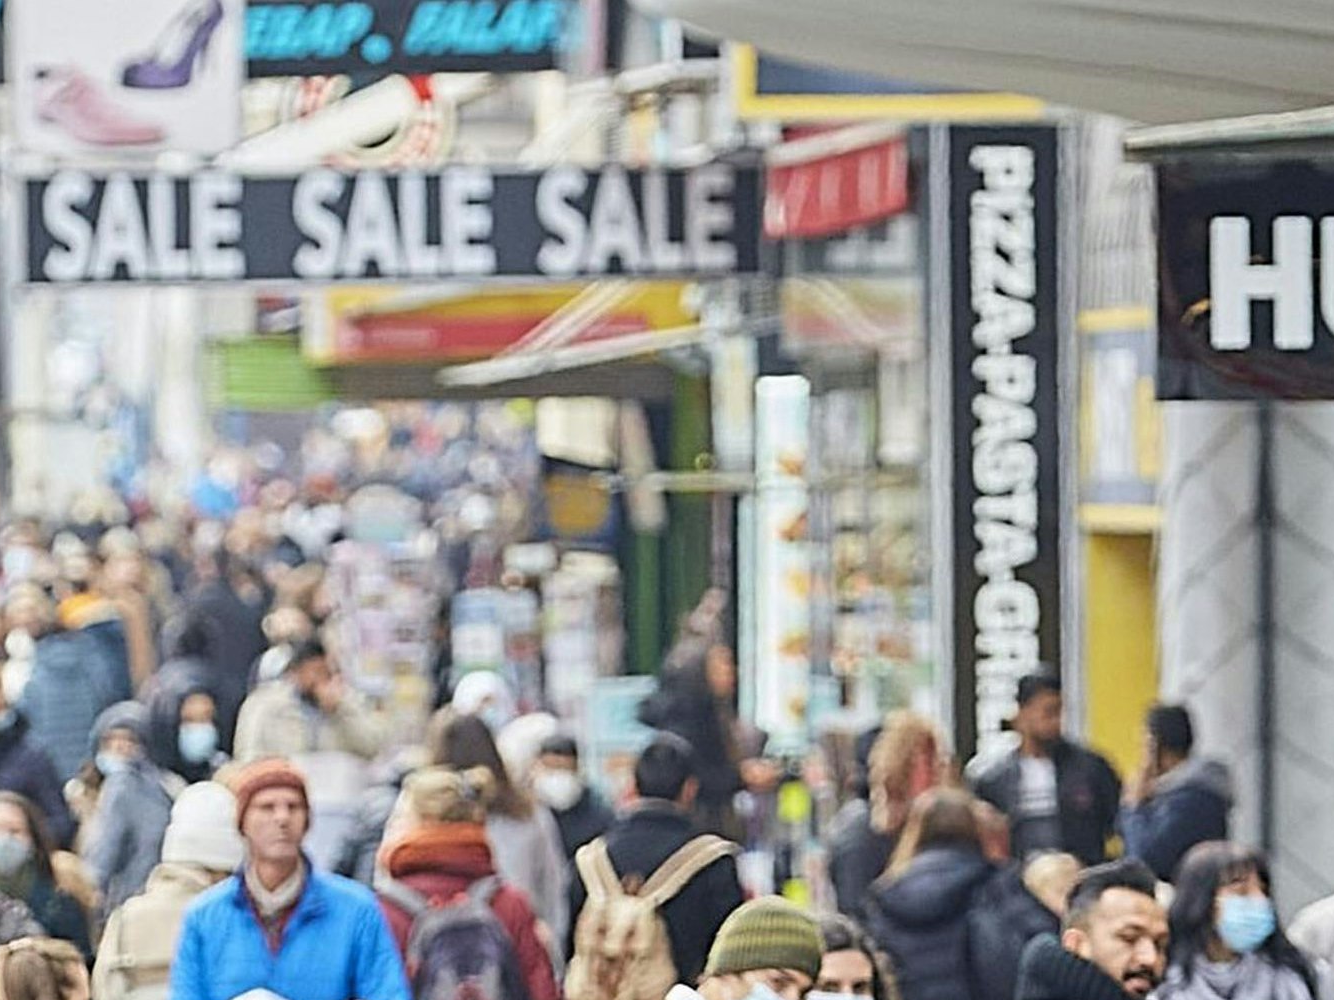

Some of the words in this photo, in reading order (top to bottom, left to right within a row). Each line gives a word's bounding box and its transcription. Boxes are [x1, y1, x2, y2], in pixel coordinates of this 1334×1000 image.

[41, 166, 246, 281] SALE
[291, 166, 497, 278] SALE
[534, 164, 738, 276] SALE
